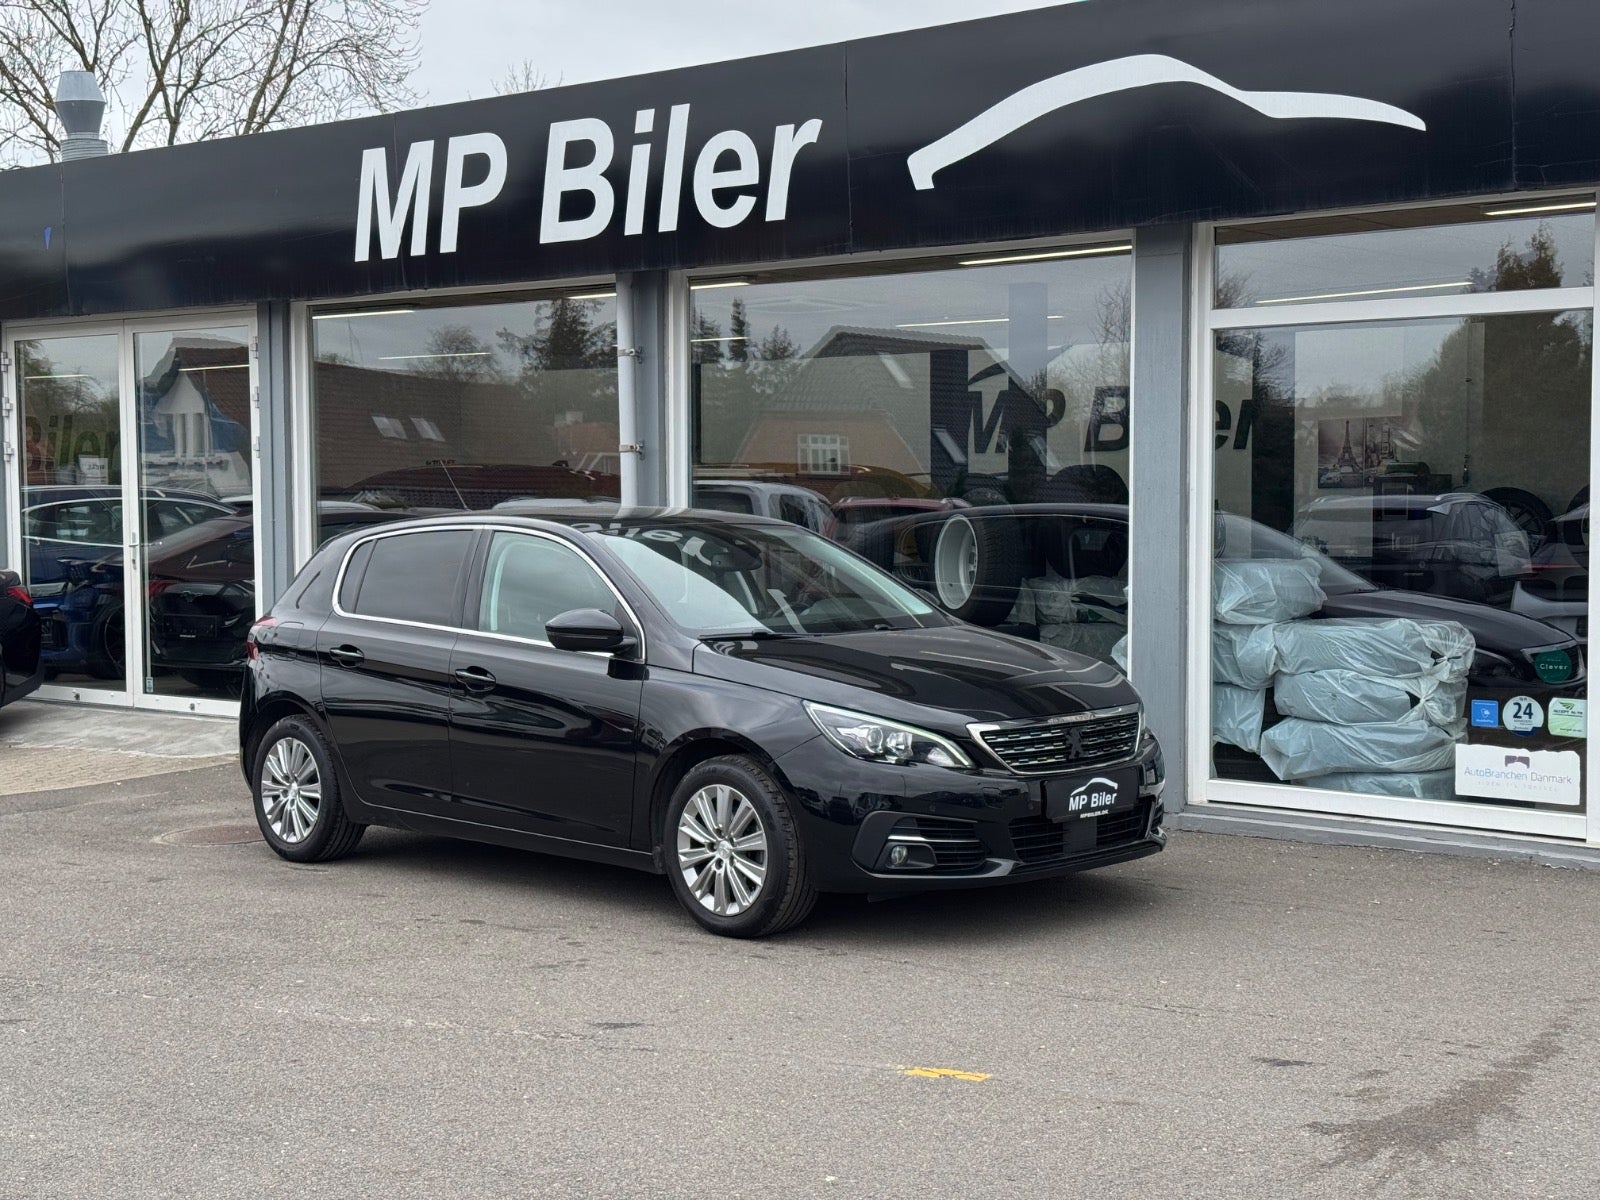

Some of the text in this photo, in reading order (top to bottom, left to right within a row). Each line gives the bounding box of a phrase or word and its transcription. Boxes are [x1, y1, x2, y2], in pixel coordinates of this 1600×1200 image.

[354, 103, 824, 263] MP Biler
[1512, 701, 1534, 720] 24
[1463, 766, 1573, 785] AutoBranchen Danmark
[1068, 791, 1118, 812] MP Biler
